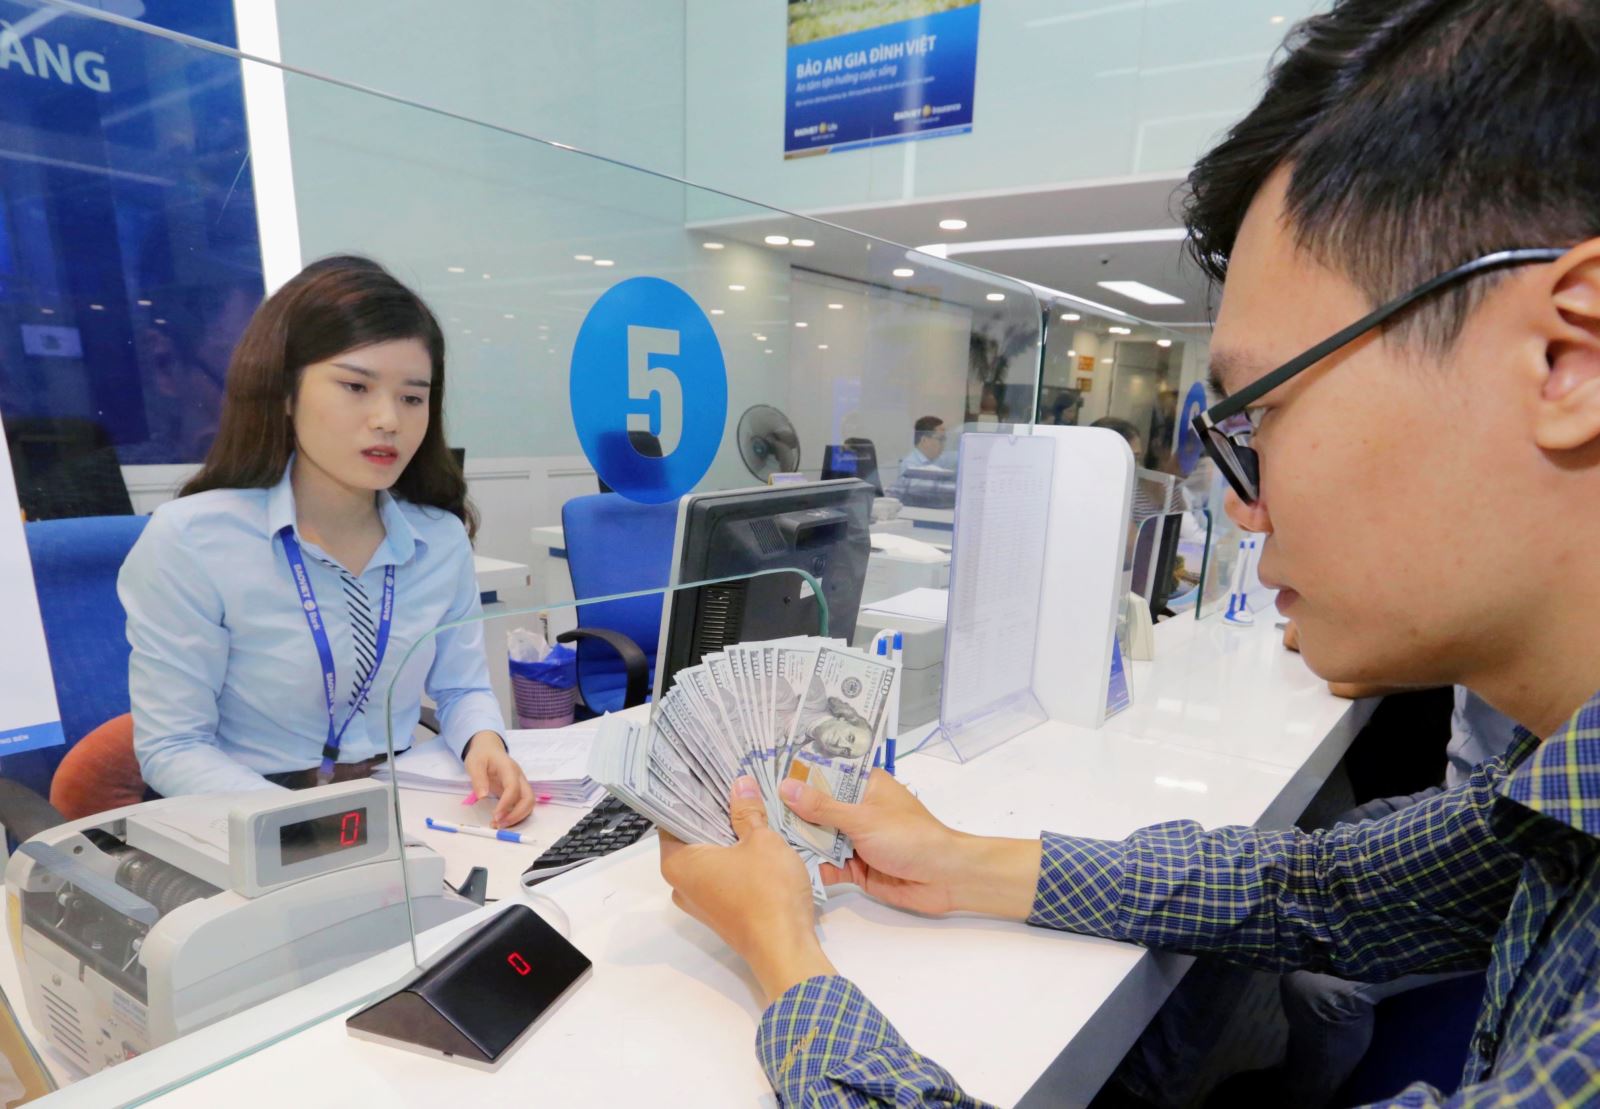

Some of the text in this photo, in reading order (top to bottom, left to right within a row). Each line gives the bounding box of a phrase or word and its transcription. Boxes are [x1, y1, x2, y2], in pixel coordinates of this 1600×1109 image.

[796, 34, 936, 79] BẢO AN GIA ĐÌNH VIỆT
[626, 324, 684, 458] 5
[339, 811, 361, 847] 0
[507, 951, 532, 976] 0
